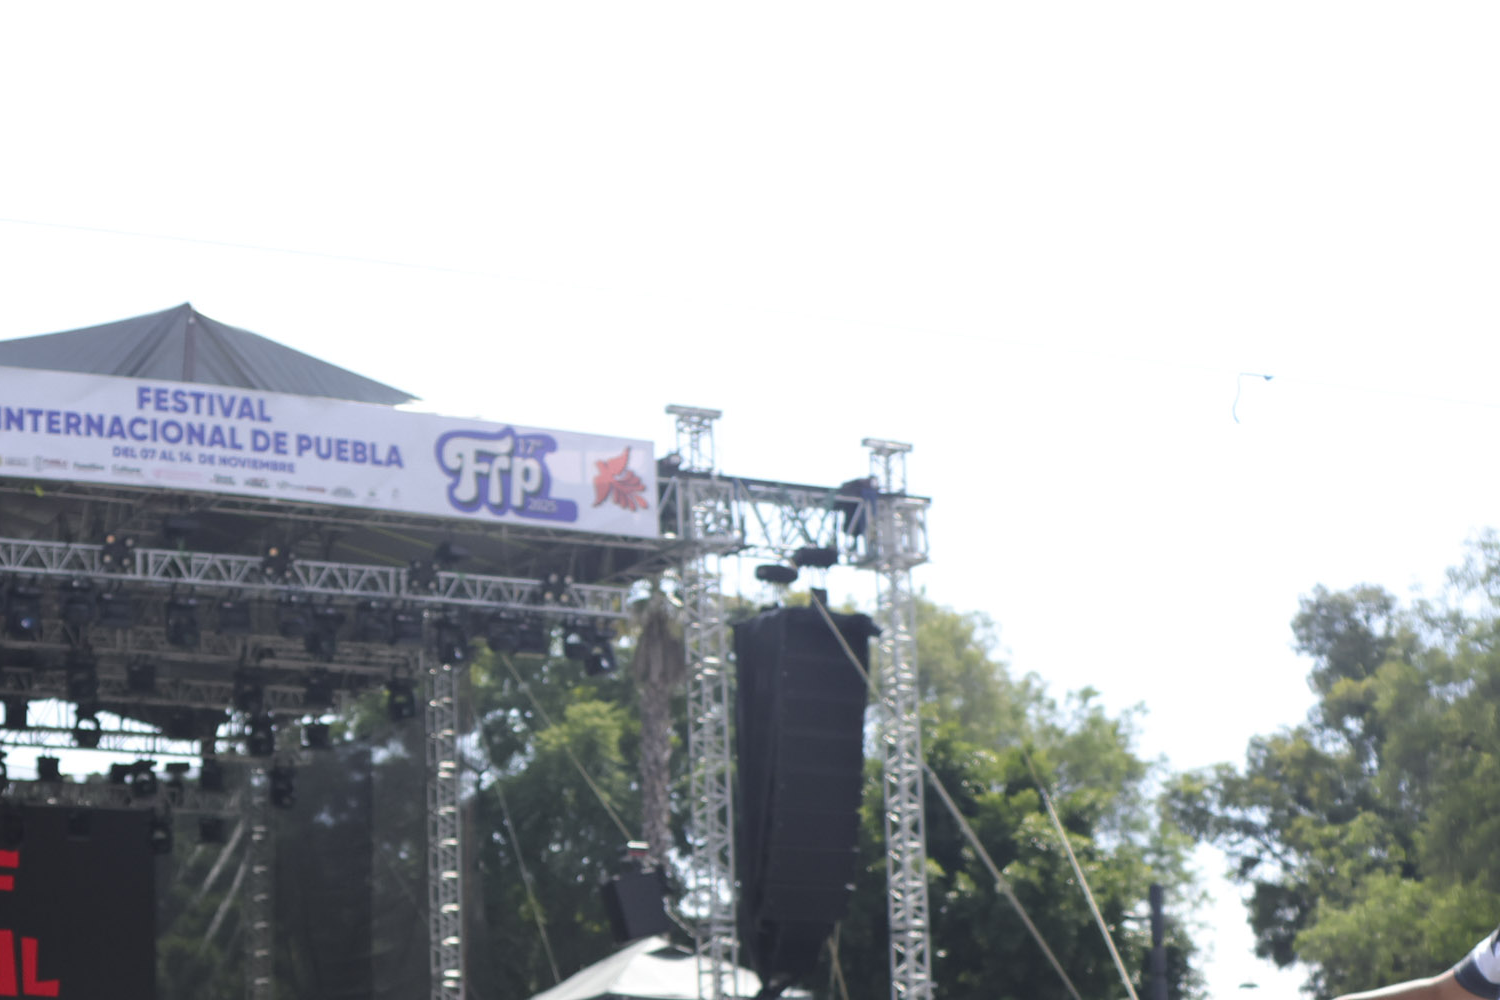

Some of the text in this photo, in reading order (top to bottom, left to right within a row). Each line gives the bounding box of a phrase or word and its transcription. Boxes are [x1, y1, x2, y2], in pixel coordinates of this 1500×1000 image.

[137, 386, 272, 422] FESTIVAL
[113, 446, 138, 460] DEL
[141, 448, 157, 460] 07
[159, 449, 176, 462] AL
[199, 453, 215, 465] DE
[219, 454, 296, 474] NOVIEMBRE
[251, 429, 289, 455] DE
[296, 434, 404, 468] PUEBLA
